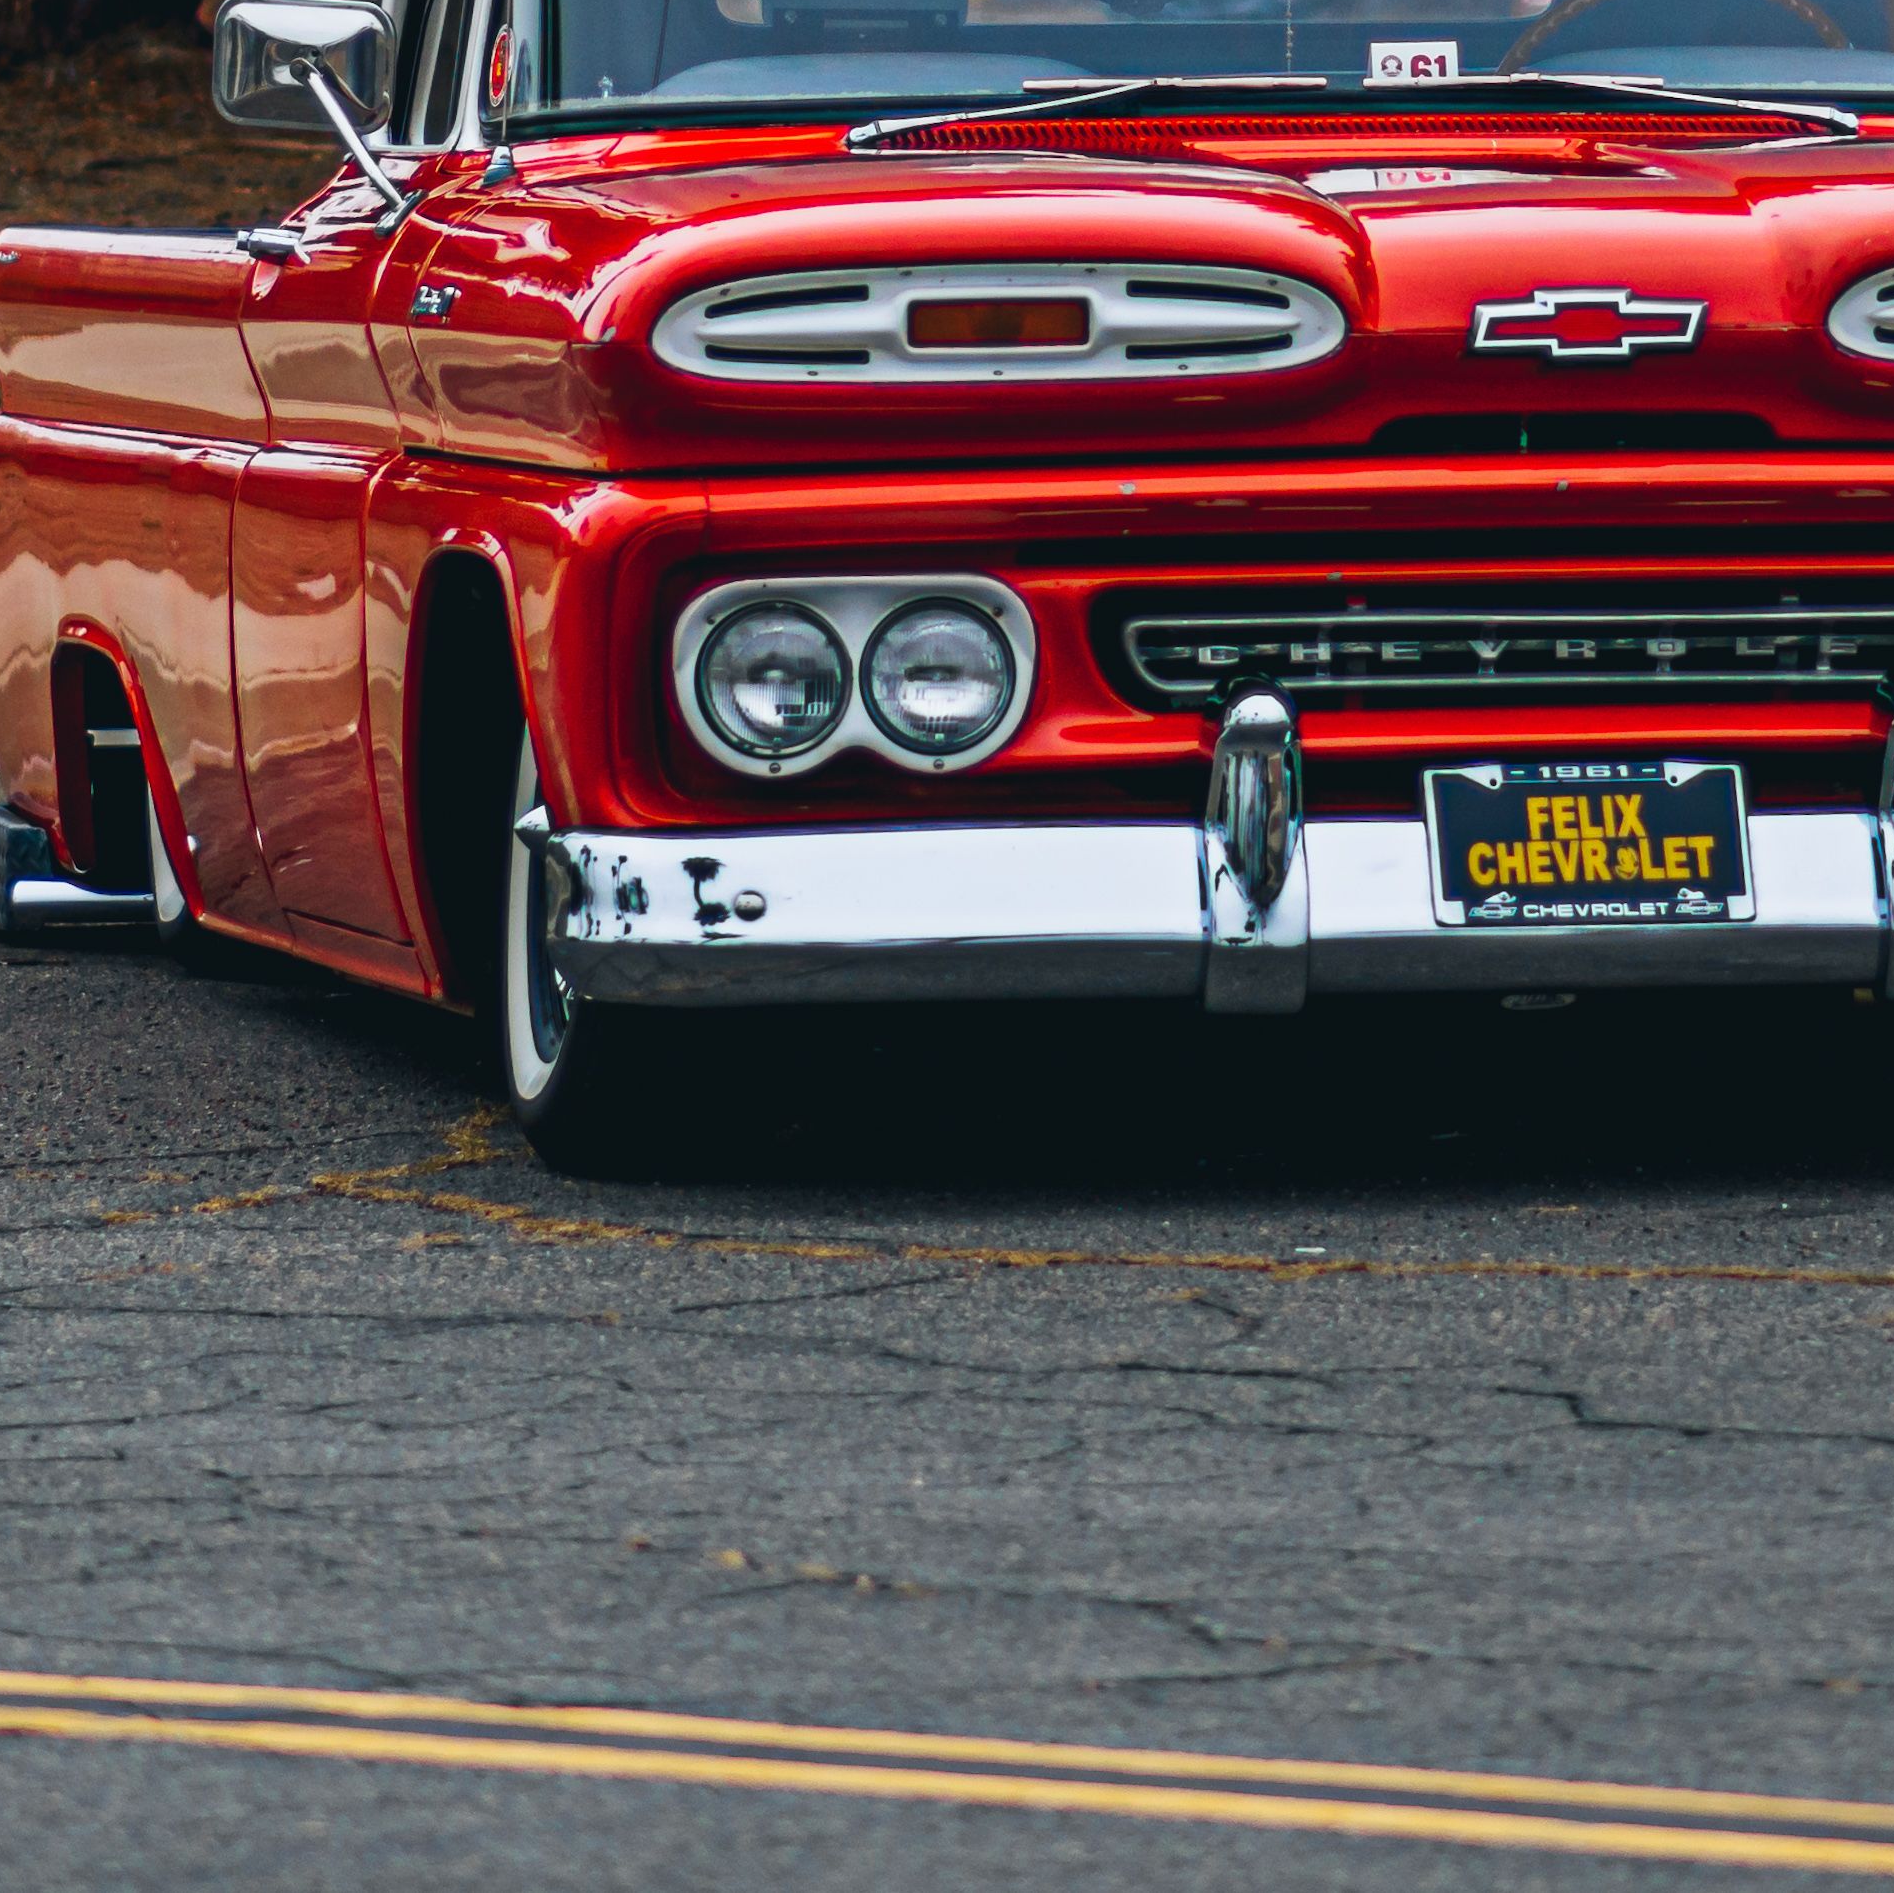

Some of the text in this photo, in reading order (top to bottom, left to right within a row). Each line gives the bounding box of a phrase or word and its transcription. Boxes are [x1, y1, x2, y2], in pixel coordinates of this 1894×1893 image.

[1410, 54, 1447, 78] 61
[1538, 764, 1628, 779] 1961
[1526, 794, 1646, 840] FELIX
[1468, 836, 1715, 885] CHEVRLET
[1522, 901, 1669, 918] CHEVROLET
